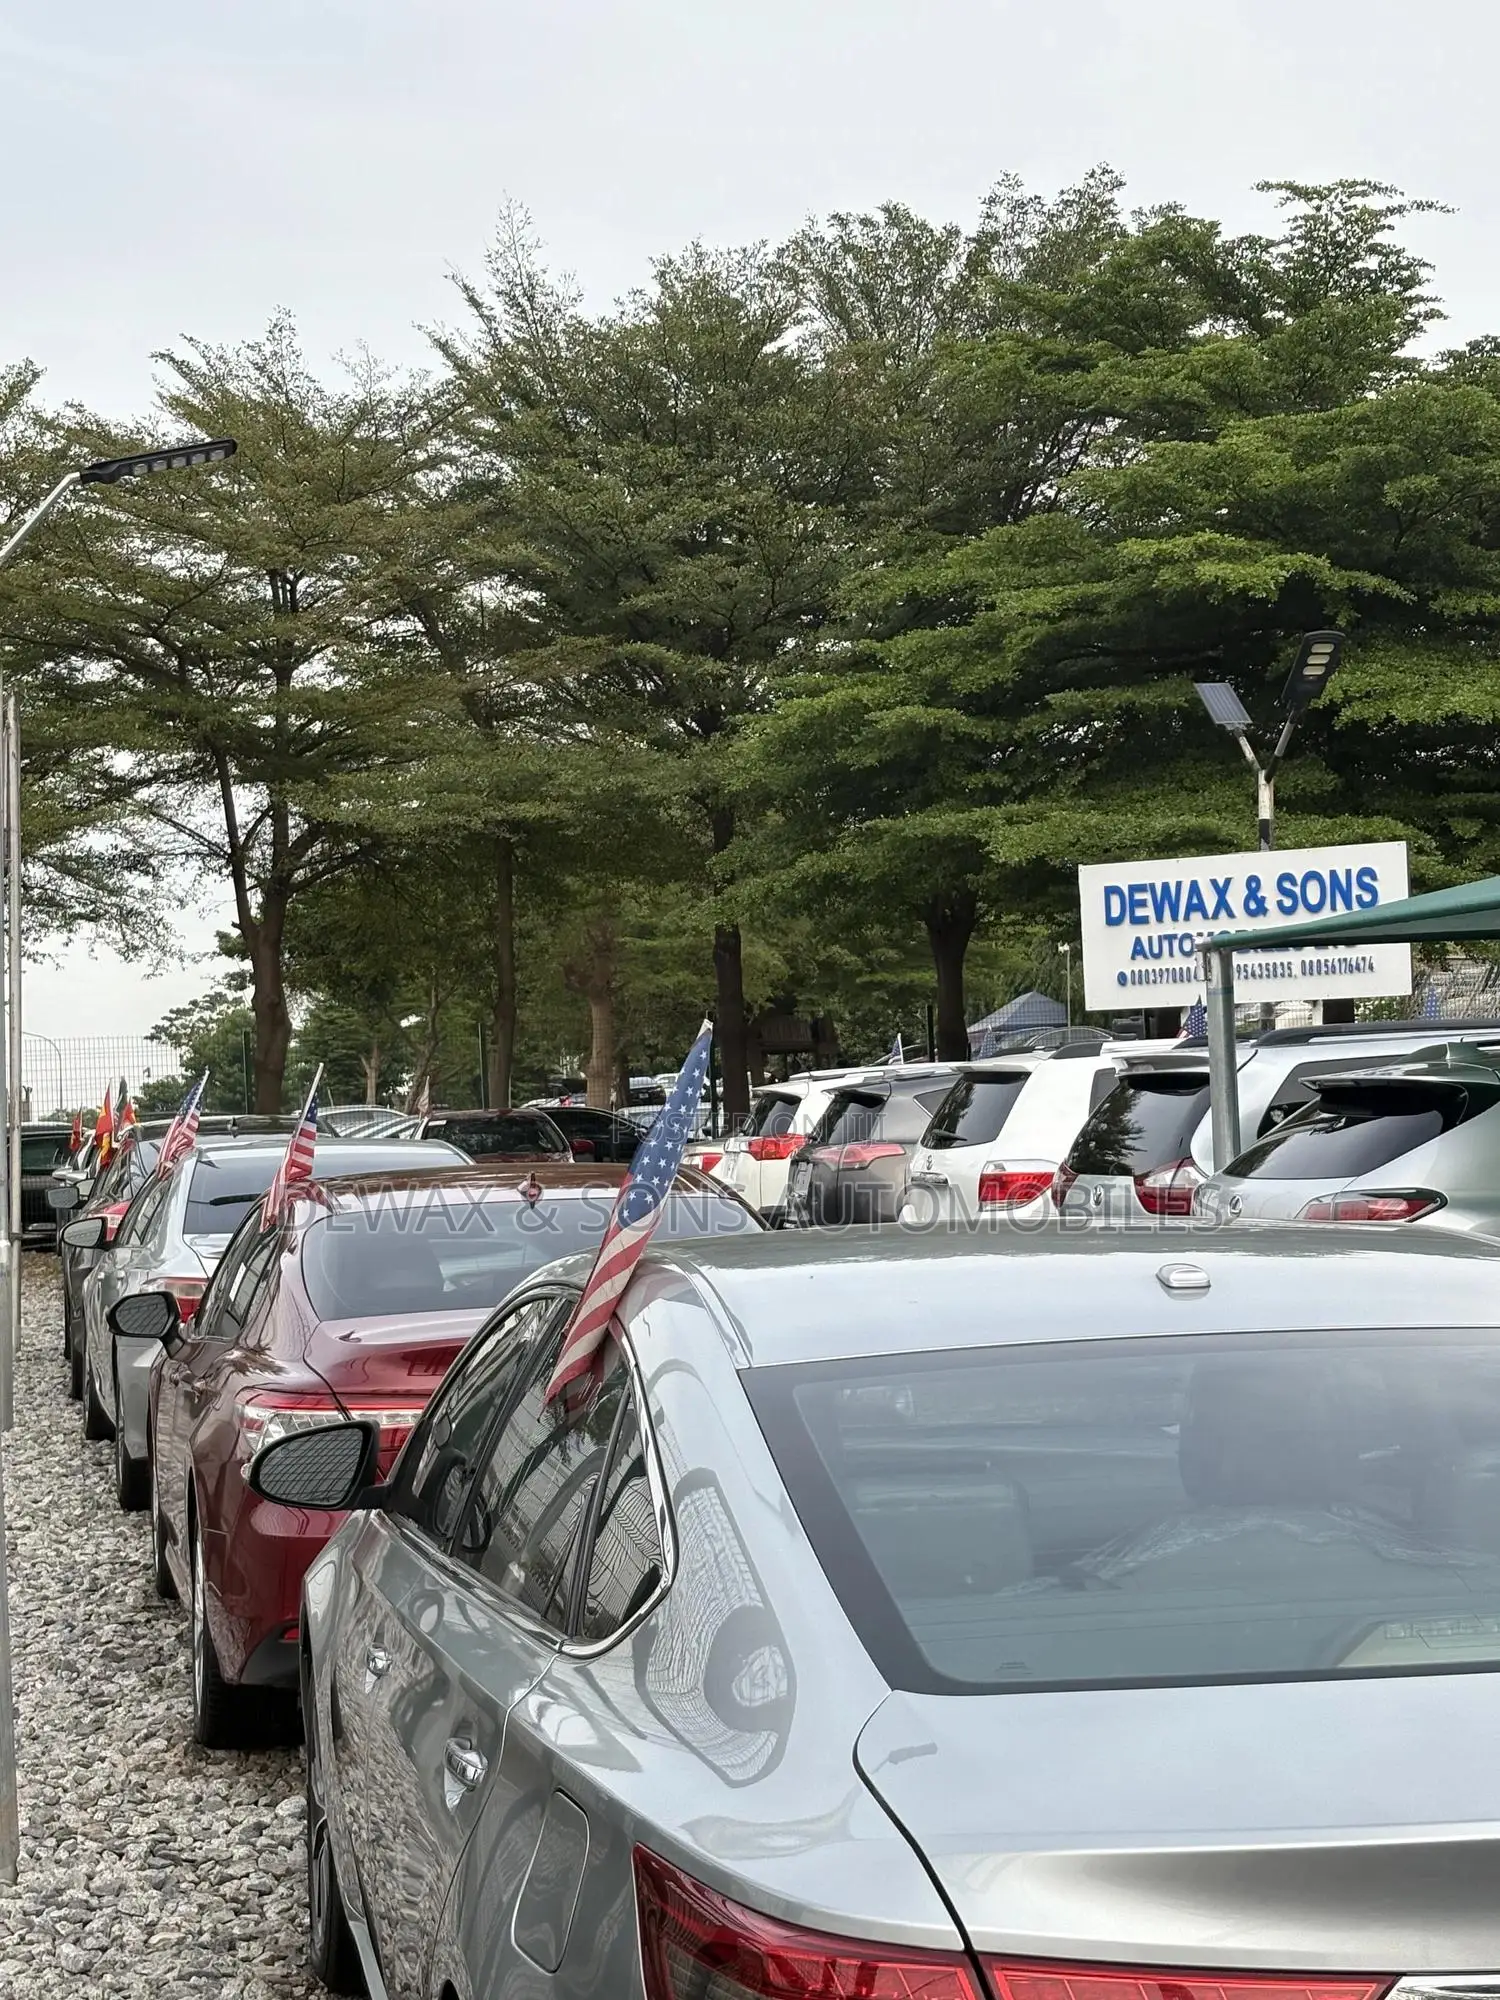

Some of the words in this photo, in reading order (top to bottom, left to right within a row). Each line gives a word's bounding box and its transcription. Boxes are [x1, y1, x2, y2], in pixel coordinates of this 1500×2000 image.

[1104, 877, 1236, 926] DEWAX
[1243, 874, 1269, 918] &
[1276, 866, 1380, 914] SONS
